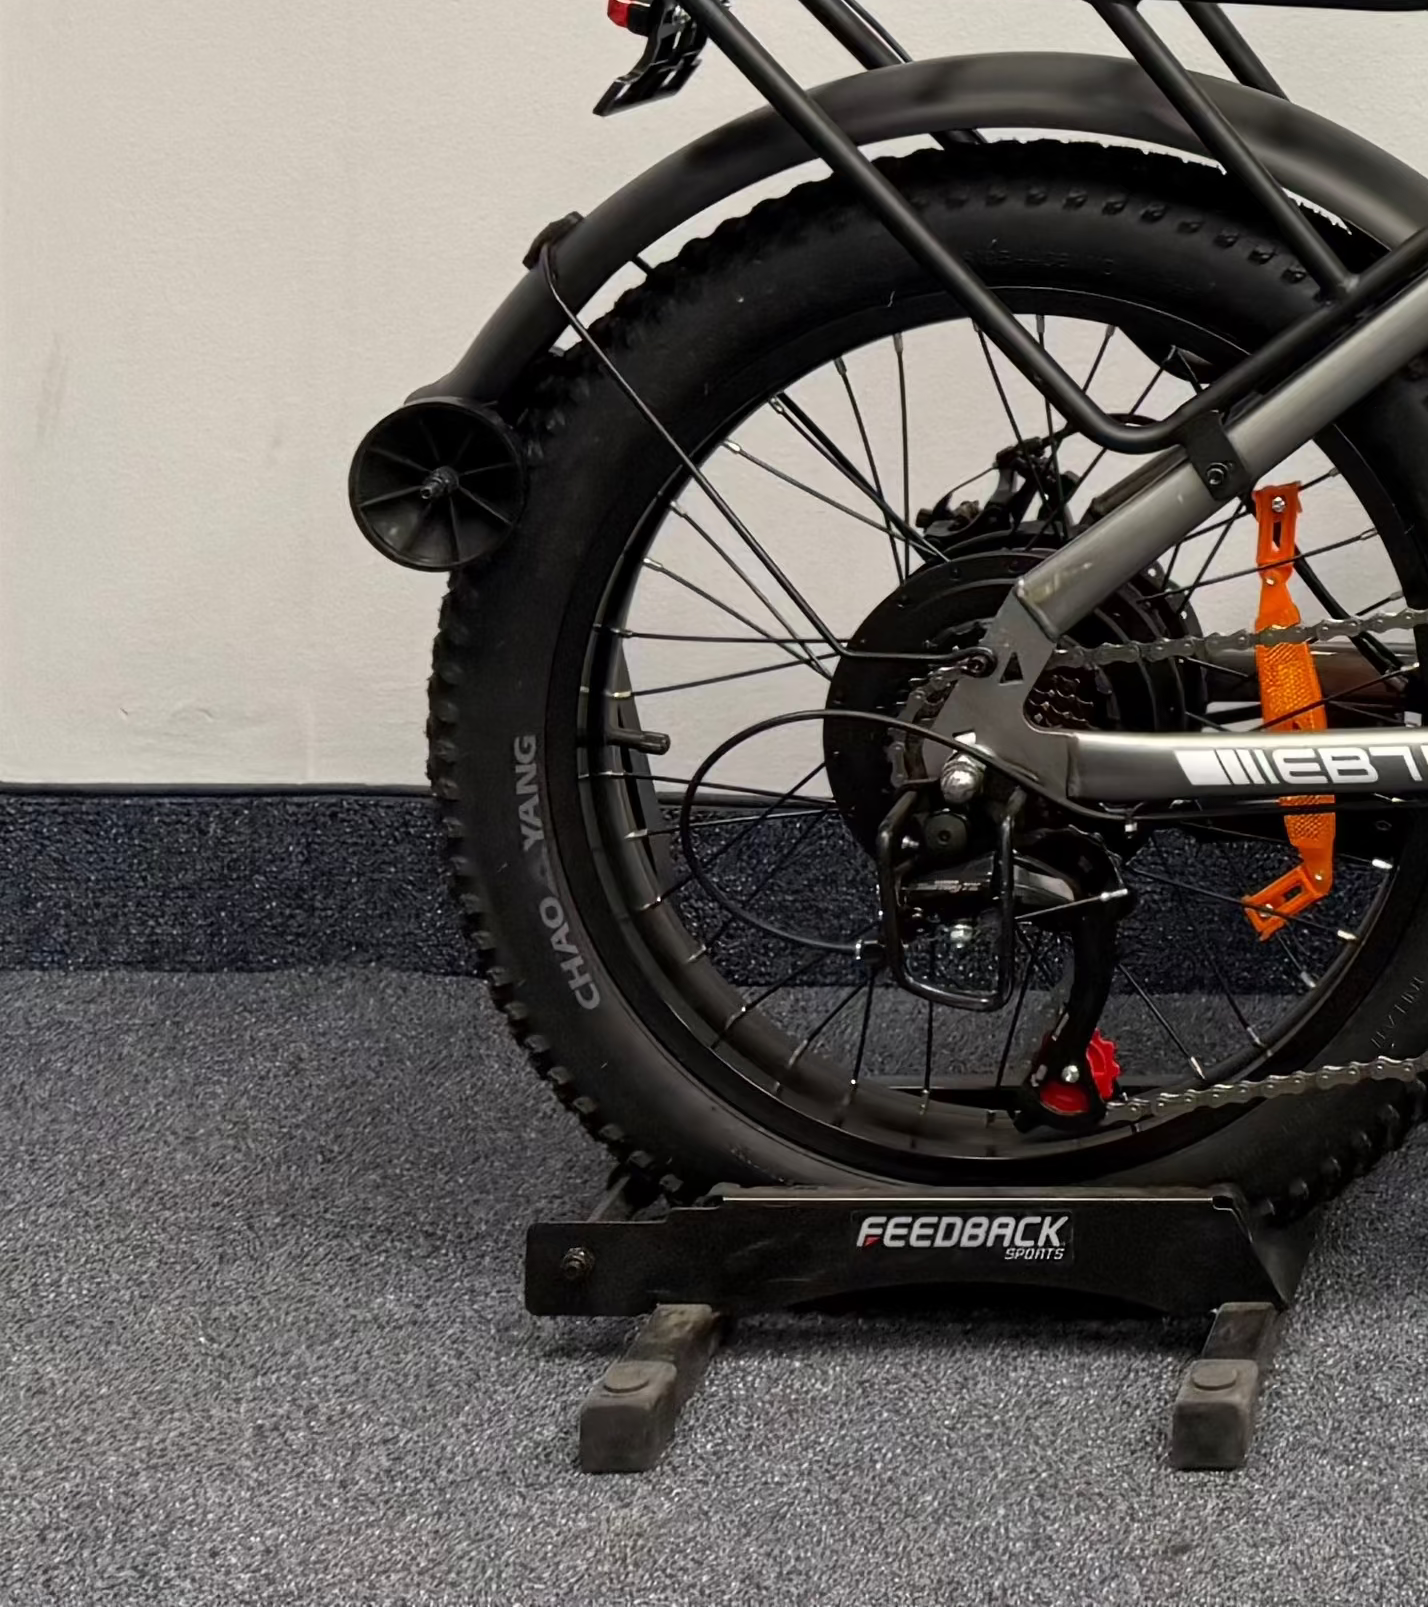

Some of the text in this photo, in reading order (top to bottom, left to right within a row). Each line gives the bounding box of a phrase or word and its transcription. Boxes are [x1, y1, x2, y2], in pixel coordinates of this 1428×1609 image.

[514, 734, 600, 1010] CHAO YANG
[856, 1216, 1069, 1248] FEEDBACK
[1004, 1248, 1065, 1260] SPORTS
